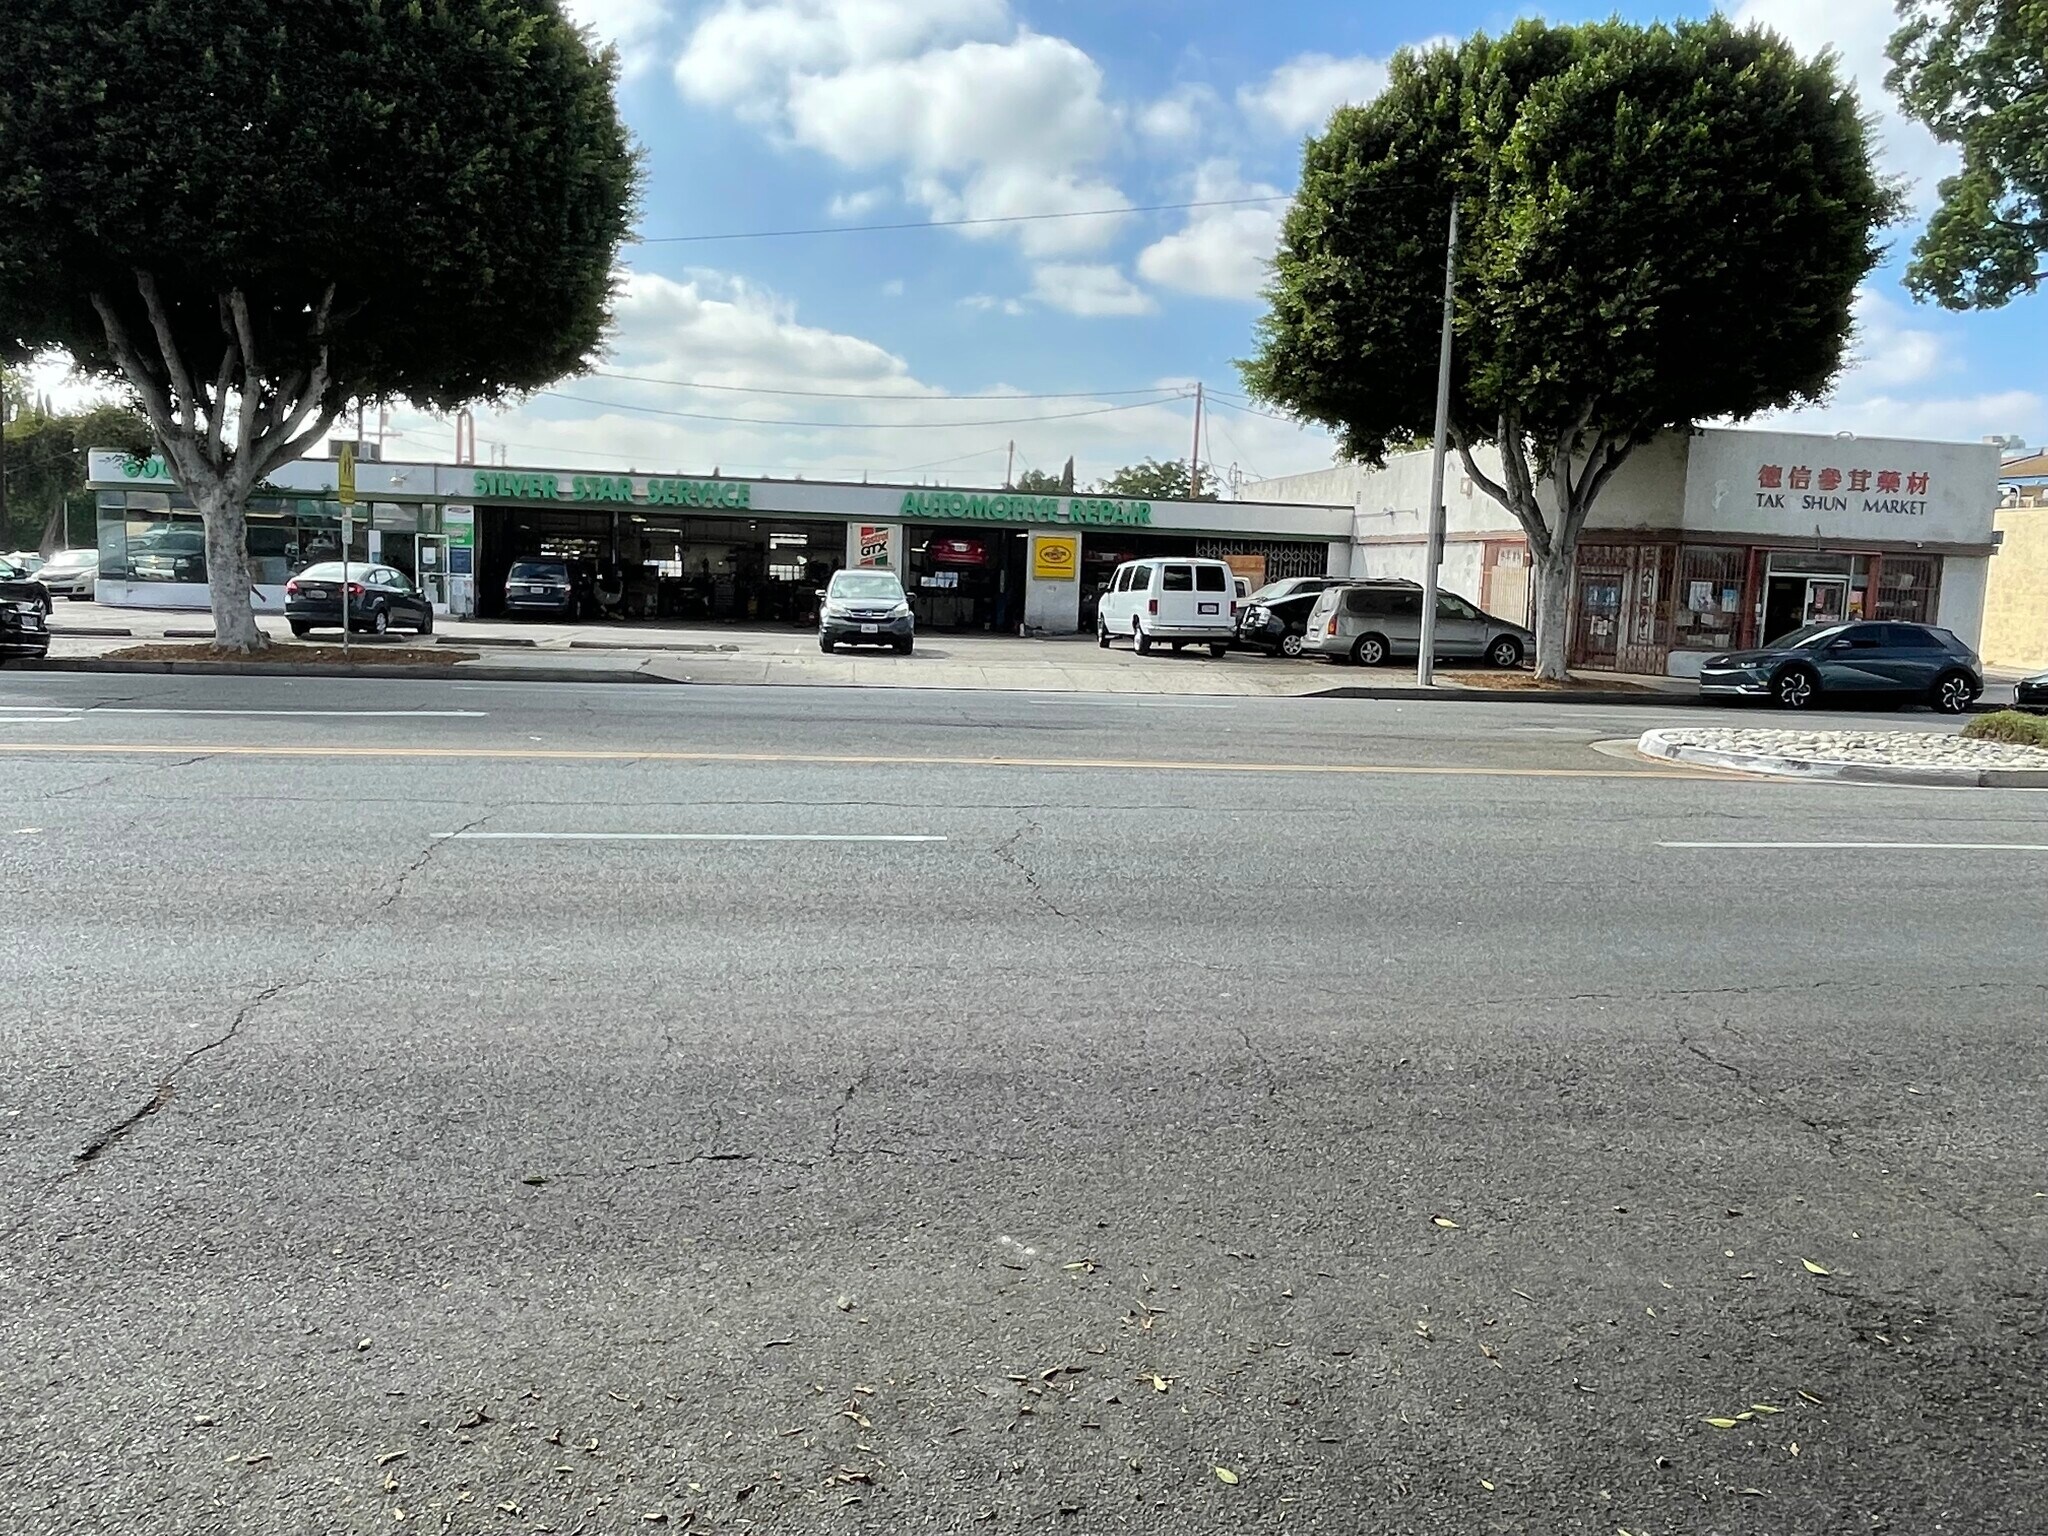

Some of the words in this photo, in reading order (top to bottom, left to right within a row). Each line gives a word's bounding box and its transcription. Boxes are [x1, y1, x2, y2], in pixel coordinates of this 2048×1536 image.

[473, 470, 559, 499] SILVER
[572, 475, 633, 502] STAR
[647, 479, 750, 507] SERVICE
[900, 492, 1059, 521] AUTOMOTIVE
[1069, 499, 1152, 525] REPAIR
[1756, 493, 1786, 509] TAK
[1802, 494, 1847, 512] SHUN
[1862, 498, 1927, 515] MARKET
[860, 540, 888, 556] GTX
